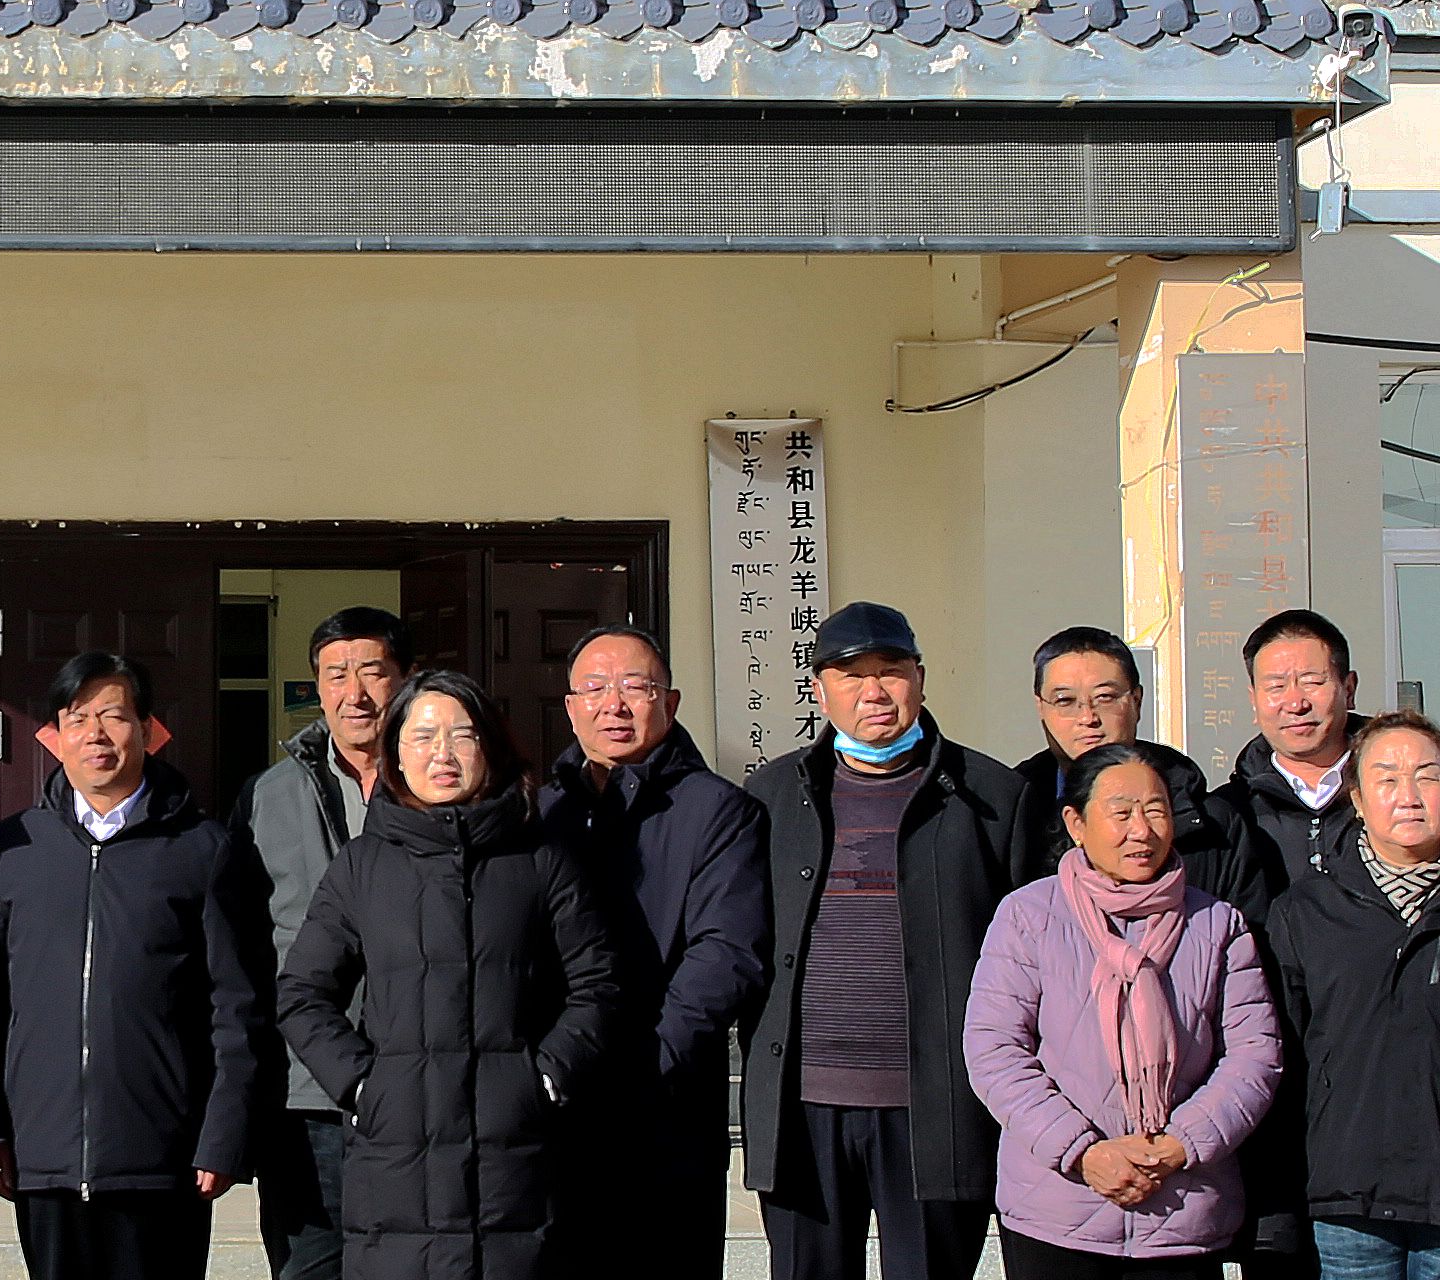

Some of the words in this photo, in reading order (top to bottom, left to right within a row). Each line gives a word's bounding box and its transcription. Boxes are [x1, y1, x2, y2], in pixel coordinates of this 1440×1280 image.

[784, 430, 823, 750] 共和县龙羊峡镇克才
